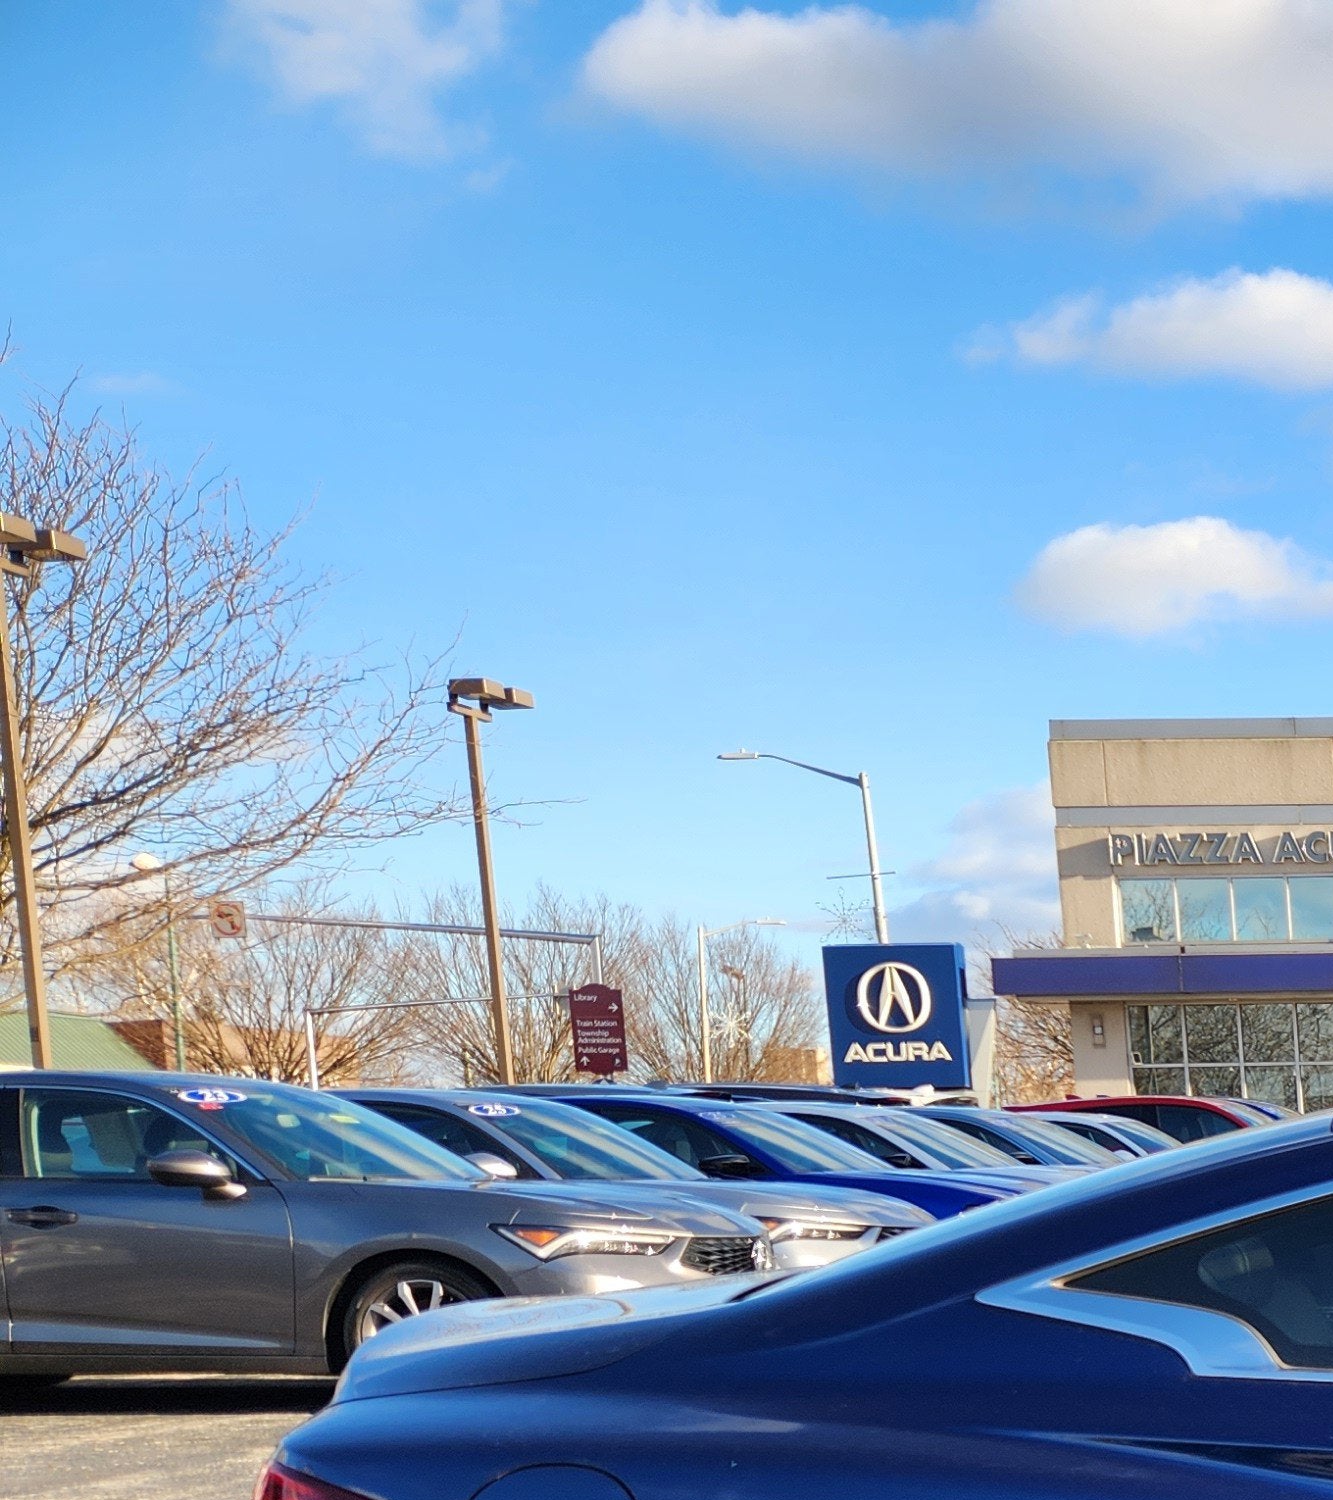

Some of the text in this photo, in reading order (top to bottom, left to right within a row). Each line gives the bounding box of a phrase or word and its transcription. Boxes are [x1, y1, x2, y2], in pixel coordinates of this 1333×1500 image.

[1108, 832, 1264, 866] PIAZZA
[573, 994, 598, 1002] Library
[843, 1040, 953, 1062] ACURA
